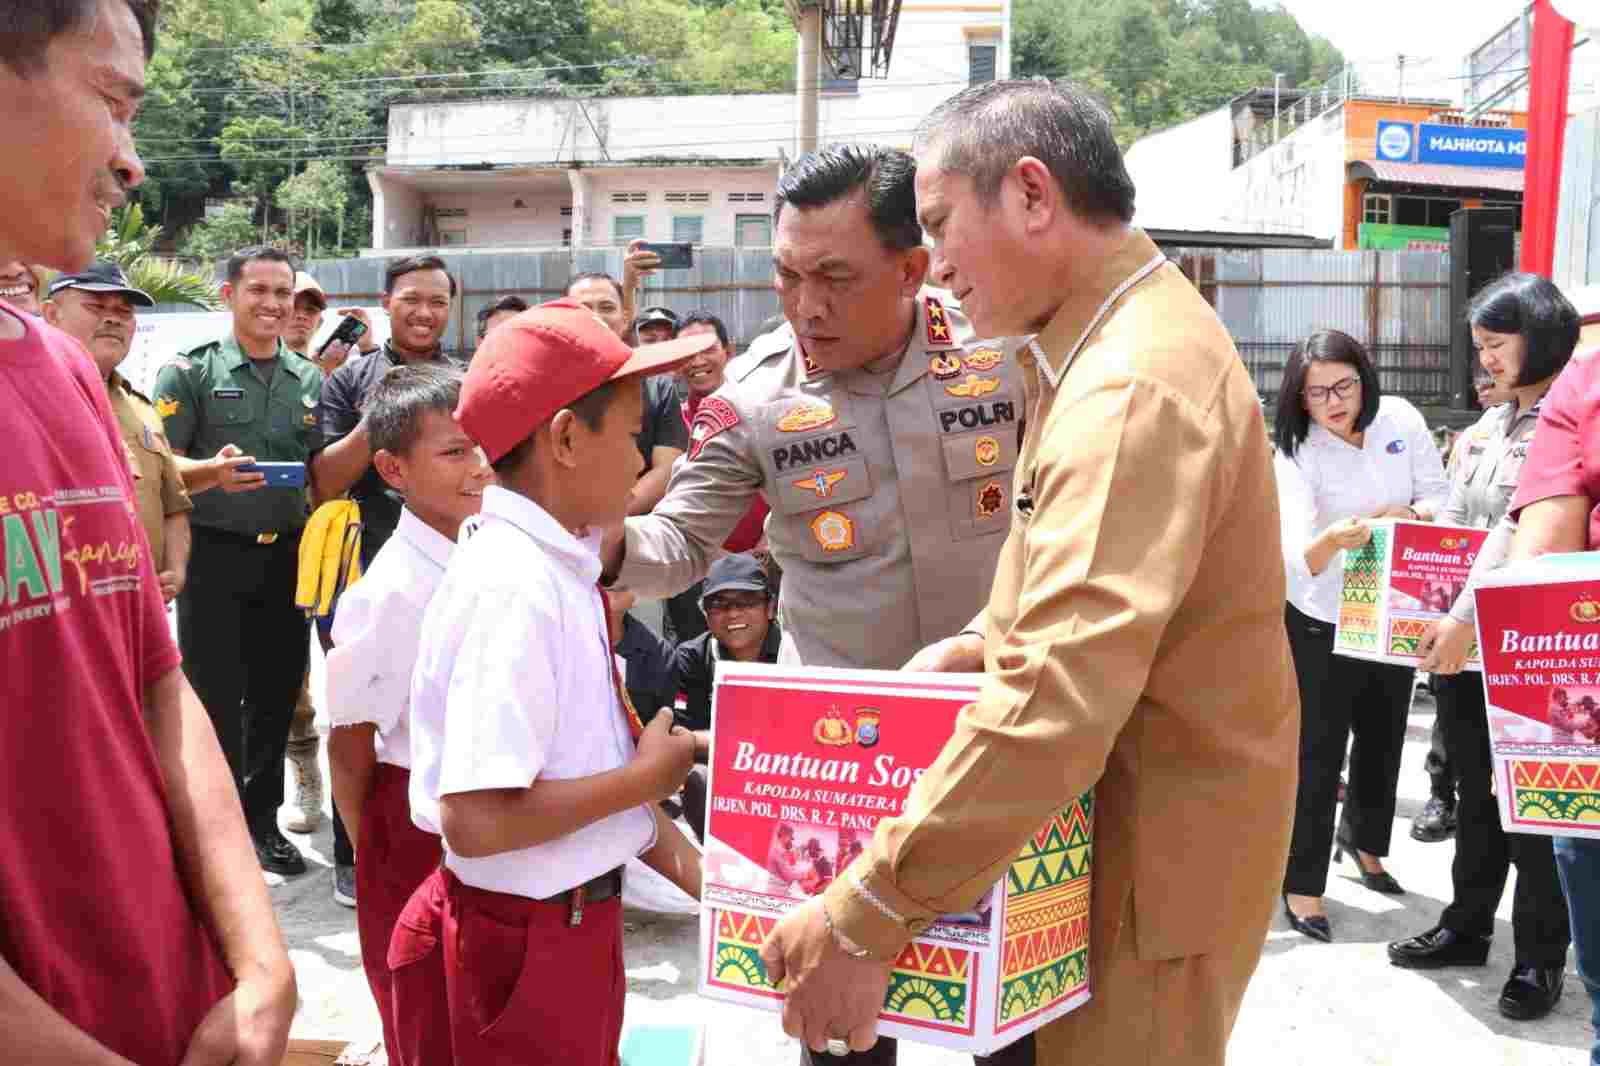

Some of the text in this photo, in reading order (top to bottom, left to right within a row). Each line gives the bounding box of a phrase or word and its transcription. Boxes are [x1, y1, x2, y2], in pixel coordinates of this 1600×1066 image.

[1429, 136, 1504, 154] MAHKOTA
[940, 401, 1015, 432] POLRI
[773, 433, 856, 470] PANCA
[1402, 548, 1461, 565] Bantuan
[1514, 658, 1576, 670] KAPOLDA
[733, 742, 859, 786] Bantuan
[713, 796, 748, 814] IRJEN.
[751, 801, 777, 818] POL.
[780, 806, 809, 823] DRS.
[744, 782, 812, 802] KAPOLDA
[814, 789, 897, 811] SUMATERA
